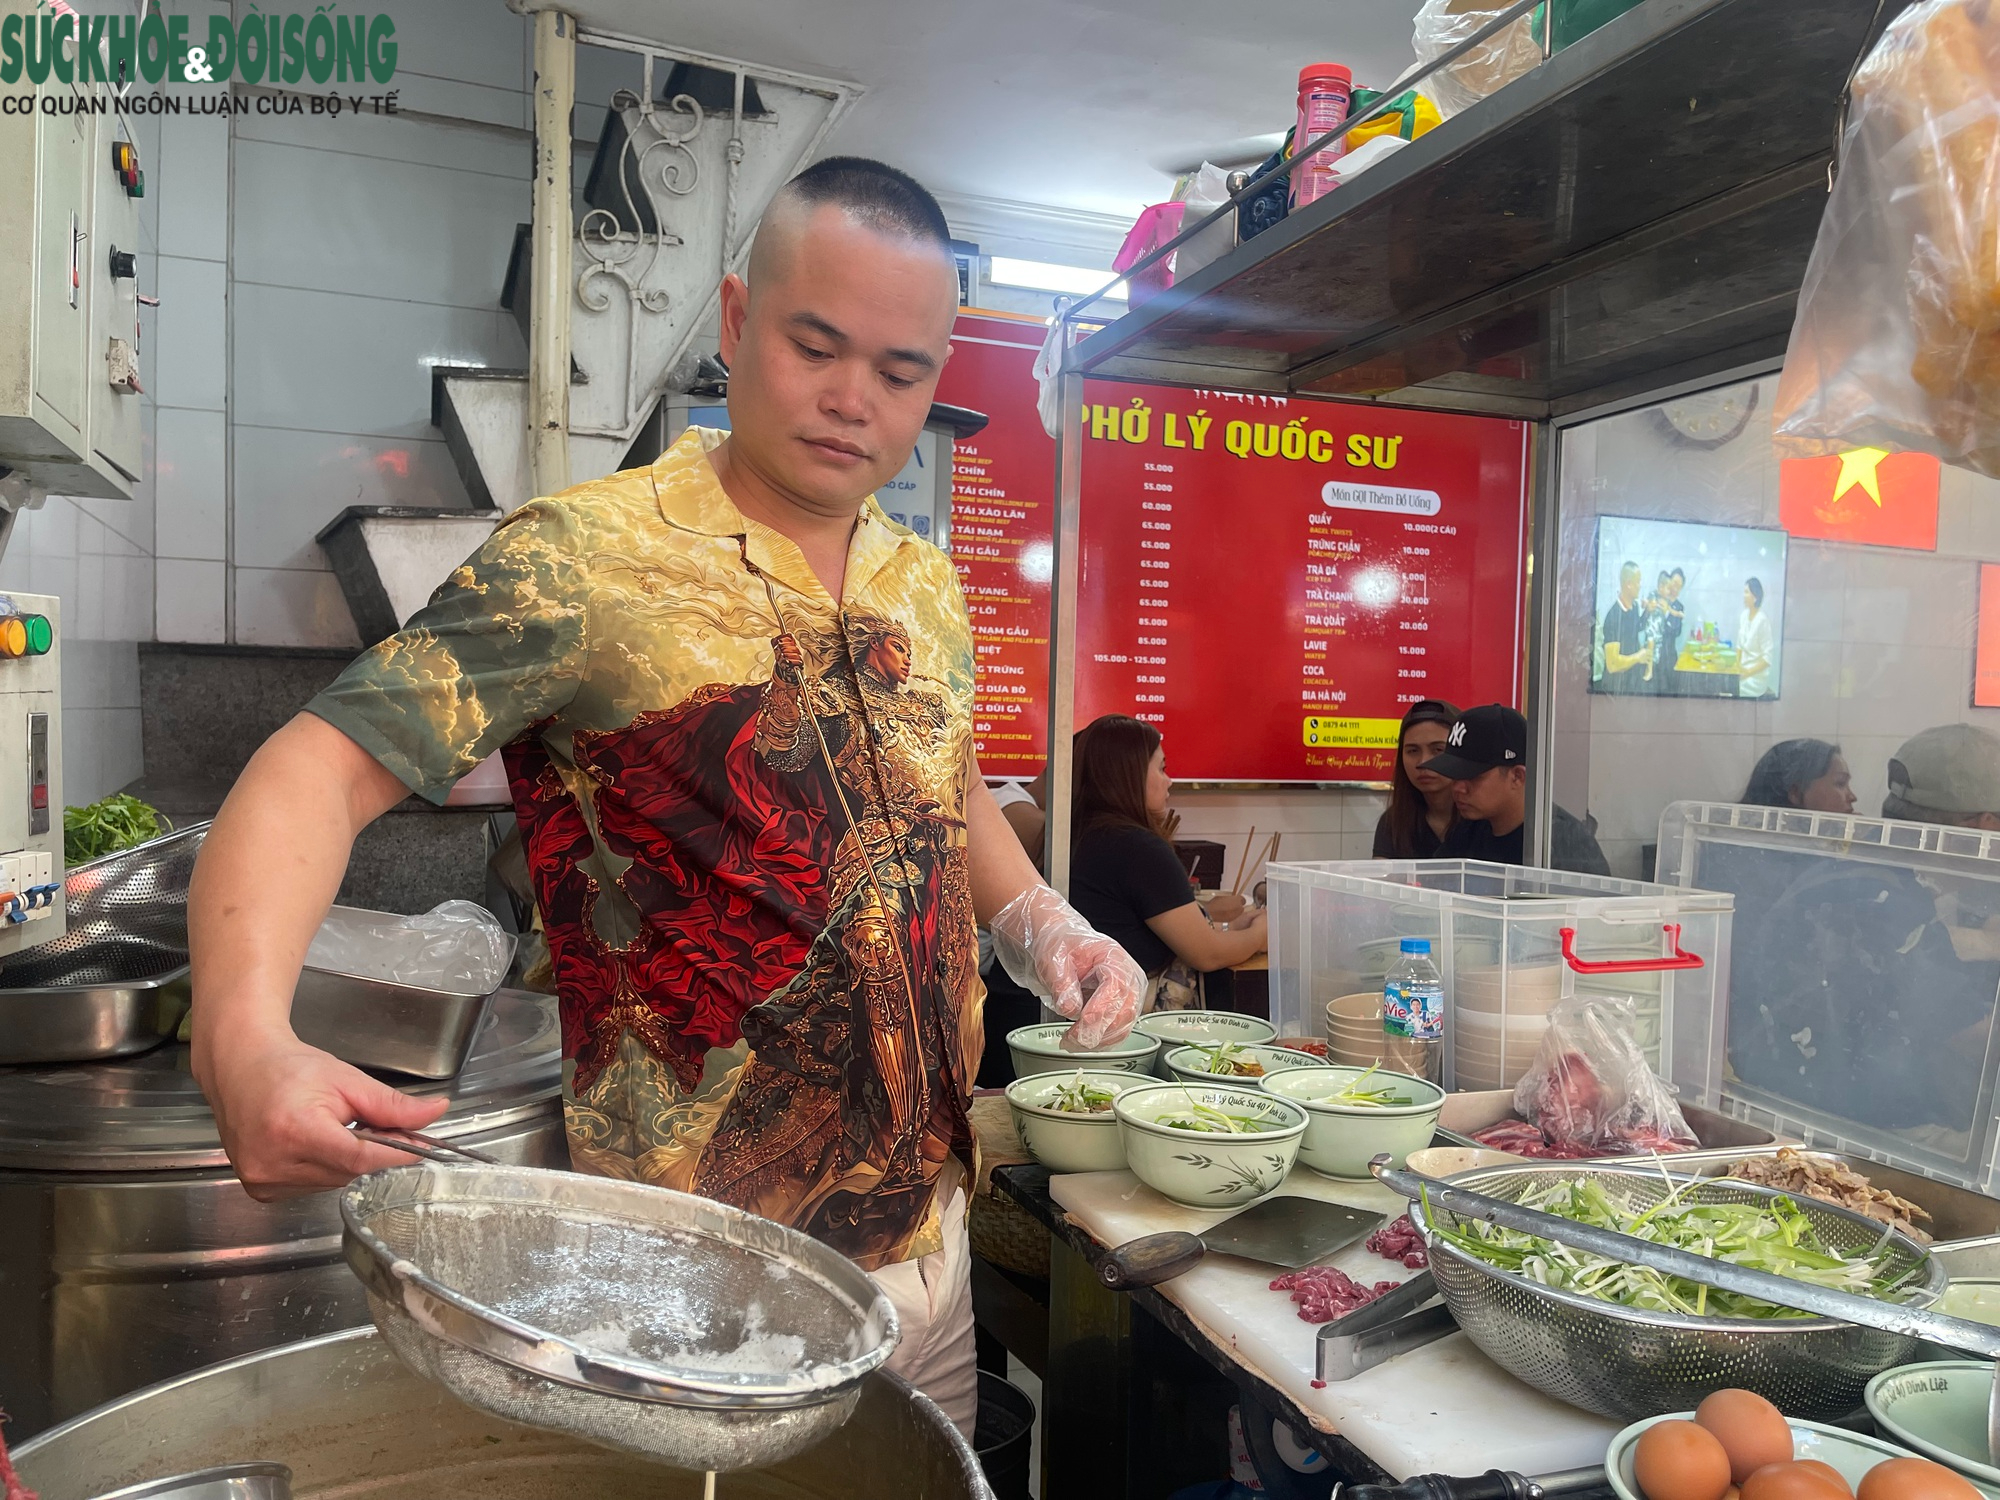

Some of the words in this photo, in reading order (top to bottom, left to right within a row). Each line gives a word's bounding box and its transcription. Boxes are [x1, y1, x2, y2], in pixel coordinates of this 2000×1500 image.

[1163, 409, 1212, 449] LÝ
[1224, 416, 1333, 462] QUỐC
[1346, 434, 1403, 470] SƯ
[958, 446, 978, 455] TÁI
[958, 466, 985, 476] CHÍN
[1144, 463, 1174, 473] 55.000
[957, 486, 976, 495] TÁI
[978, 487, 1005, 497] CHÍN
[1143, 482, 1173, 492] 55.000
[1331, 488, 1351, 501] Món
[957, 505, 975, 514] TÁI
[978, 507, 1001, 517] XÀO
[1142, 502, 1172, 511] 60.000
[956, 525, 975, 534] TÁI
[1142, 521, 1171, 531] 65.000
[956, 545, 974, 554] TÁI
[1141, 541, 1171, 550] 65.000
[1403, 546, 1430, 556] 10.000
[956, 565, 971, 574] GÀ
[1140, 560, 1170, 569] 65.000
[1306, 563, 1324, 575] TRÀ
[1140, 579, 1169, 588] 65.000
[978, 587, 1008, 596] VANG
[1305, 588, 1323, 600] TRÀ
[1139, 599, 1169, 607] 65.000
[1304, 614, 1322, 625] TRÀ
[978, 626, 1004, 636] NẠM
[1400, 621, 1428, 631] 20.000
[978, 645, 1001, 655] BIỆT
[1303, 640, 1327, 651] LAVIE
[1398, 646, 1426, 655] 15.000
[1094, 654, 1127, 663] 105.000
[1134, 656, 1166, 665] 125.000
[1303, 665, 1325, 675] COCA
[1398, 669, 1426, 678] 20.000
[1136, 675, 1166, 684] 50.000
[1011, 685, 1026, 694] BÒ
[1135, 694, 1165, 703] 60.000
[1302, 690, 1316, 700] BIA
[1317, 689, 1330, 700] HÀ
[1331, 690, 1346, 703] NỘI
[1007, 704, 1022, 713] GÀ
[976, 722, 991, 731] BÒ
[1322, 735, 1331, 743] 40
[1256, 1102, 1266, 1111] 40
[1929, 1377, 1948, 1394] Liệt
